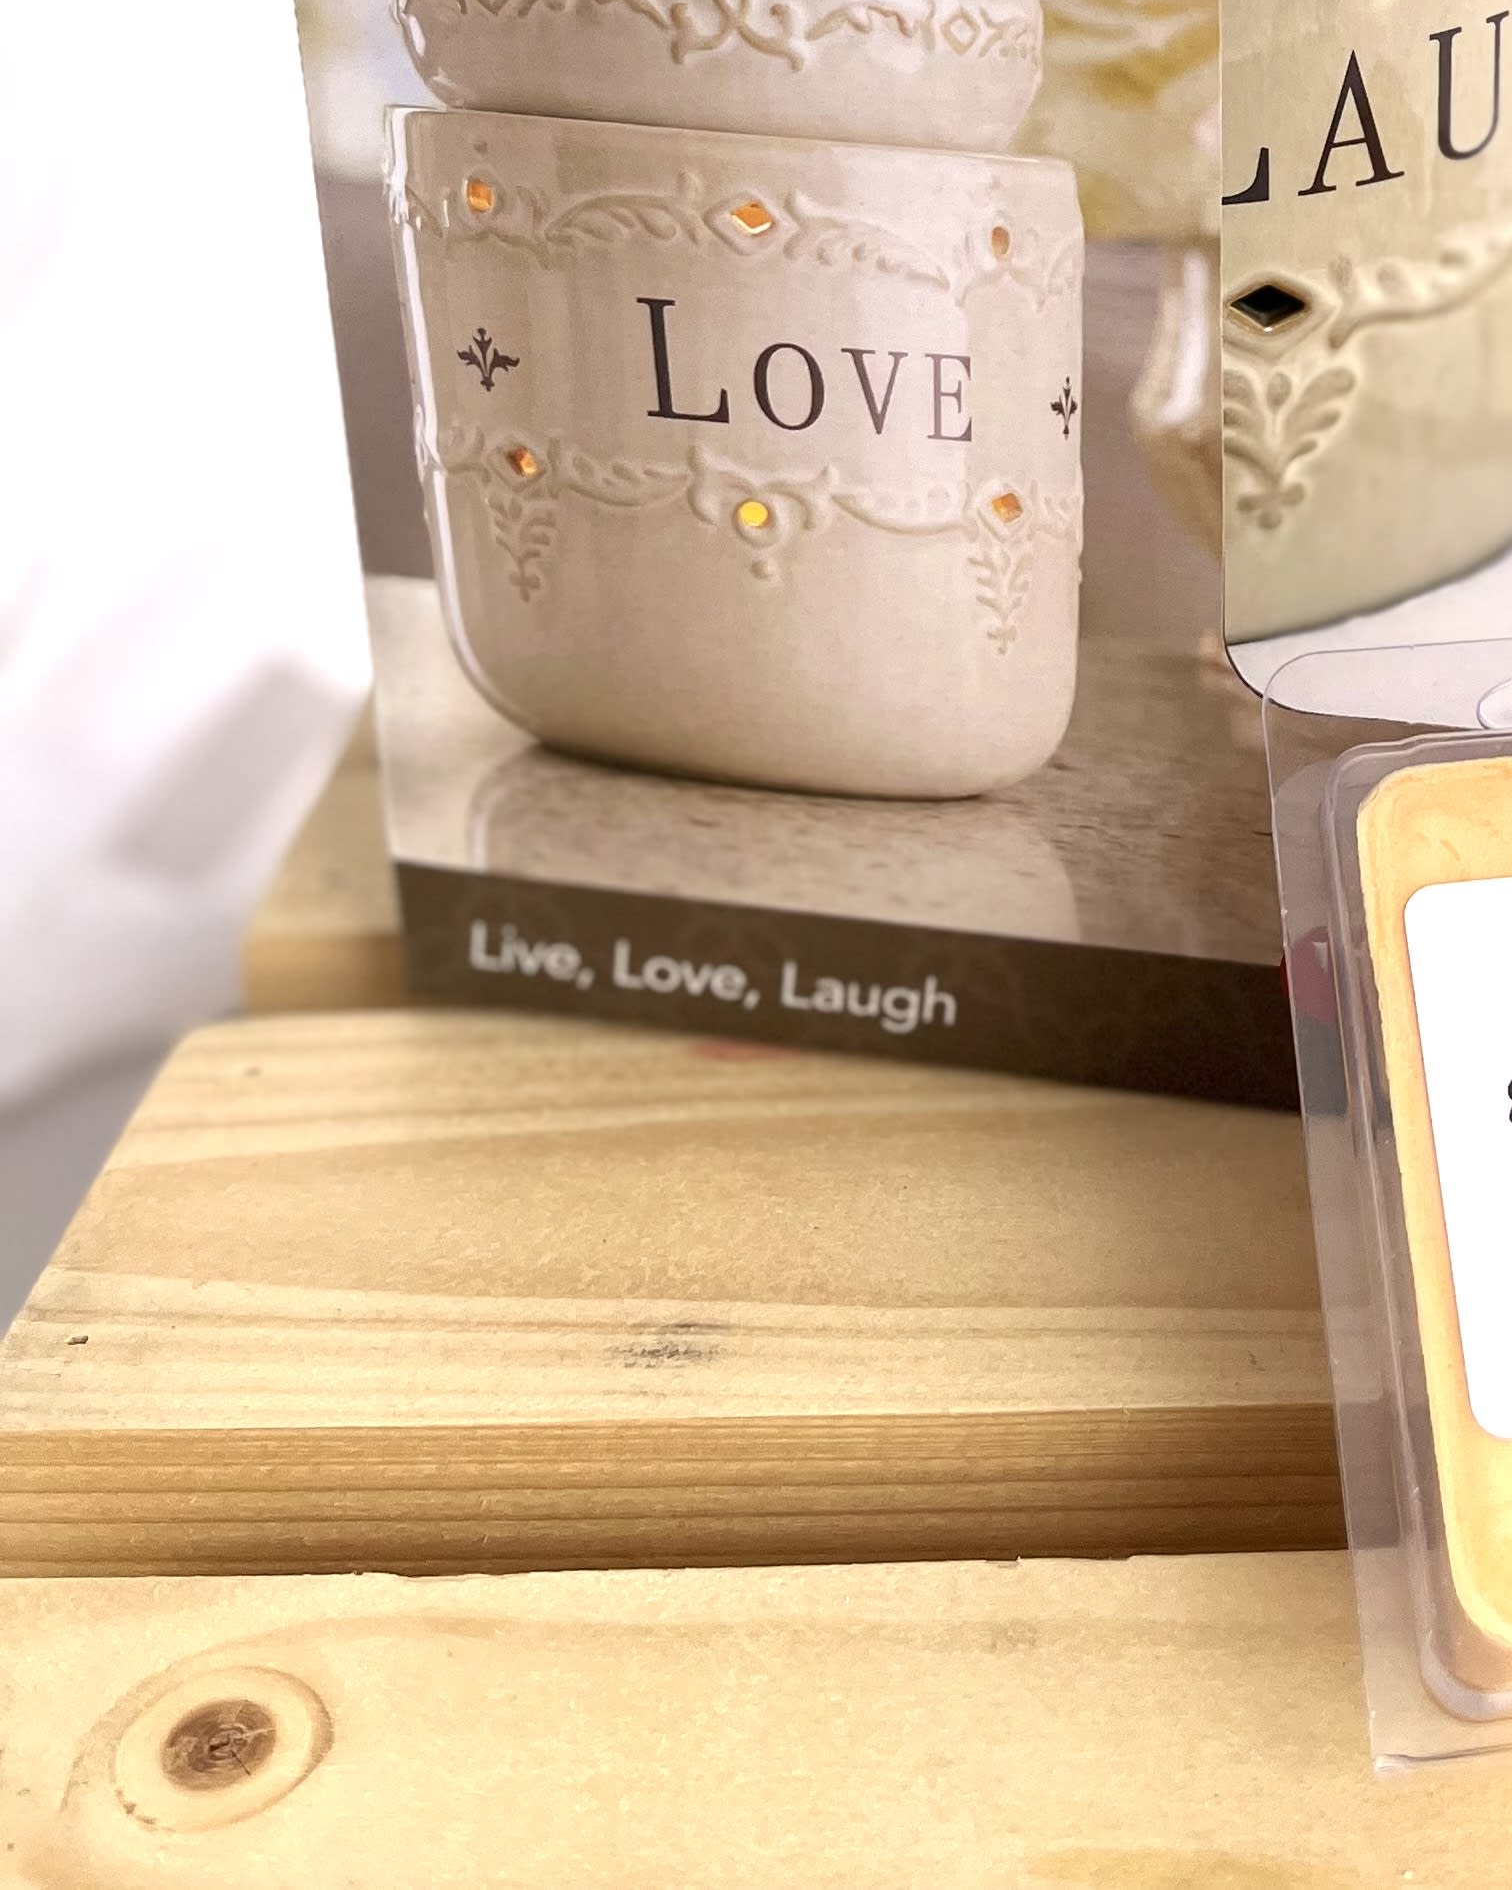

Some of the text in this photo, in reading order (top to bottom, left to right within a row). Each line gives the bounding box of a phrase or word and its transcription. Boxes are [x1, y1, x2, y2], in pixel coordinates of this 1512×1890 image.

[636, 297, 973, 443] LOVE
[469, 920, 957, 1034] Live, Love, Laugh
